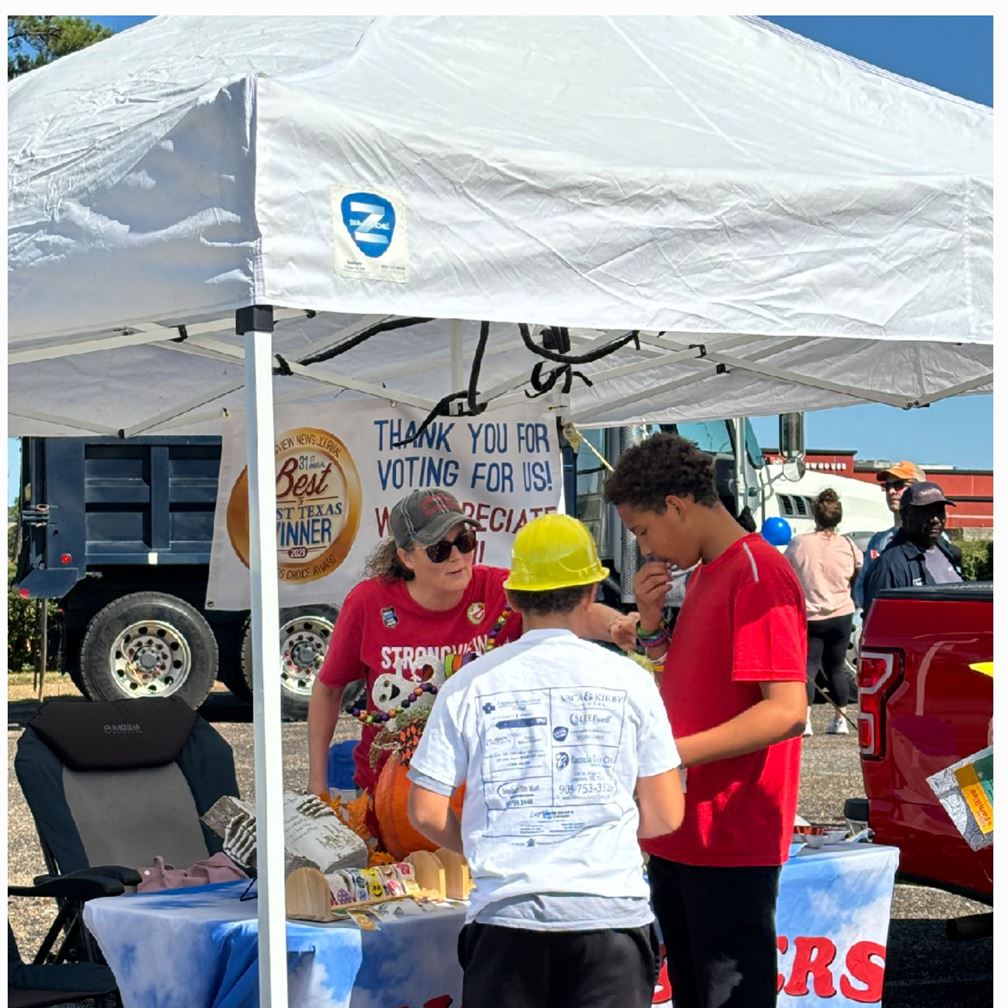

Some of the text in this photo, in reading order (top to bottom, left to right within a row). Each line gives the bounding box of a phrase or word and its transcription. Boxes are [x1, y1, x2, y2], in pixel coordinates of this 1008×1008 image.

[373, 418, 551, 454] THANK YOU FOR
[377, 456, 553, 493] VOTING FOR US!
[276, 502, 342, 520] ST TEXAS
[276, 518, 333, 547] INNER
